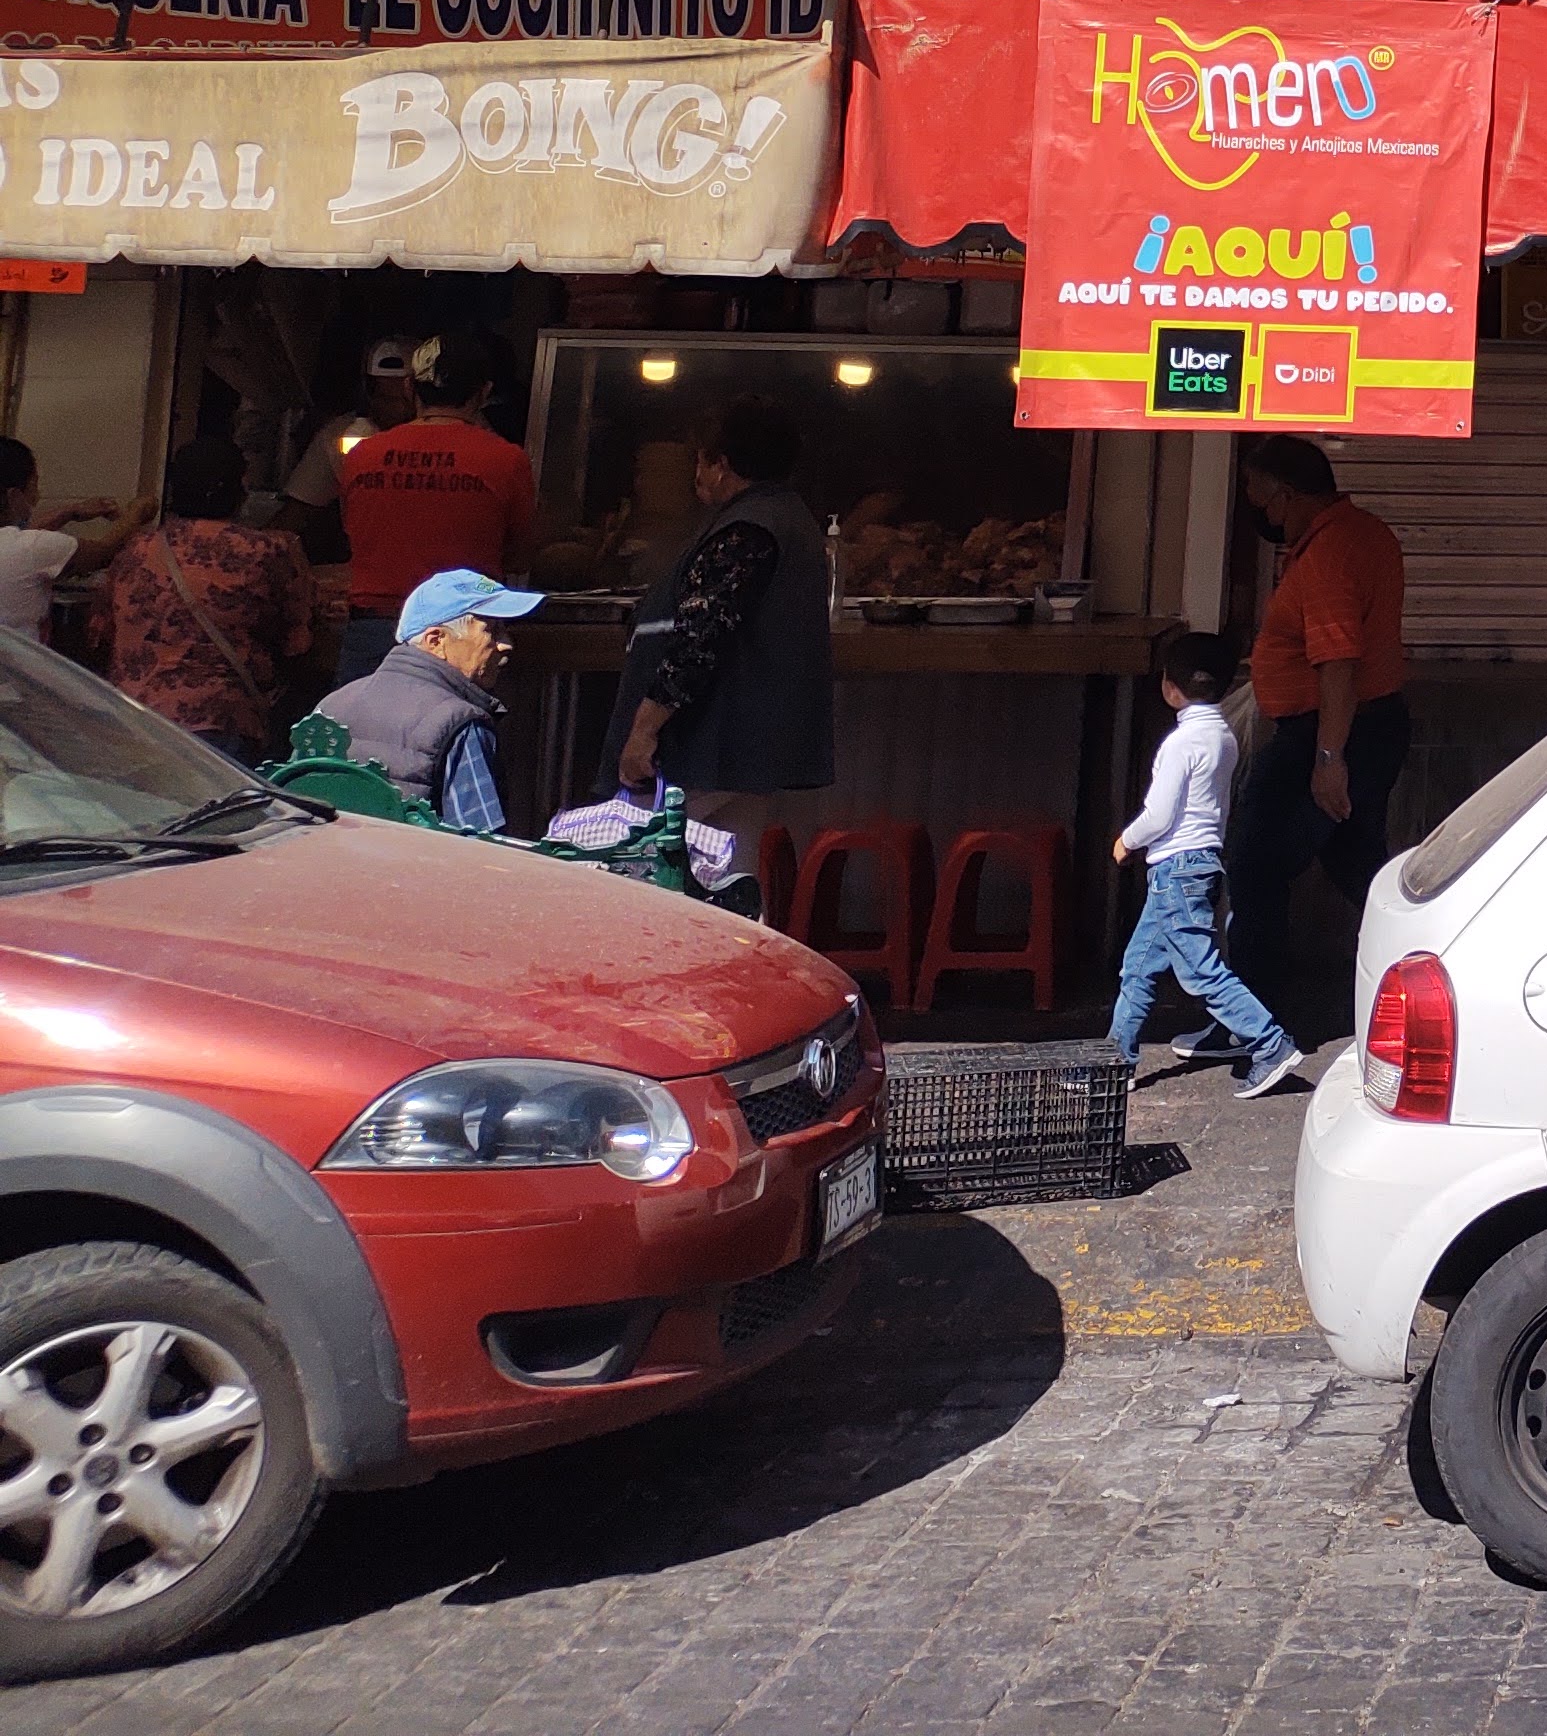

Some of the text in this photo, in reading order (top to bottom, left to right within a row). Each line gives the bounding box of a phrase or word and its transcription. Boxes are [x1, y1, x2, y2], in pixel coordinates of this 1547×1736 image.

[328, 72, 786, 224] BOING!
[1211, 132, 1440, 157] Huaraches y Antojitos Mexicanos
[33, 138, 274, 212] IDEAL
[1133, 211, 1378, 284] ¡AQUÍ!
[1139, 284, 1176, 306] TE
[1185, 285, 1288, 310] DAMOS
[1297, 289, 1338, 311] TU
[1346, 290, 1454, 315] PEDIDO.
[1169, 347, 1232, 371] Uber
[1168, 371, 1228, 393] Eats
[1302, 366, 1335, 383] DiDi
